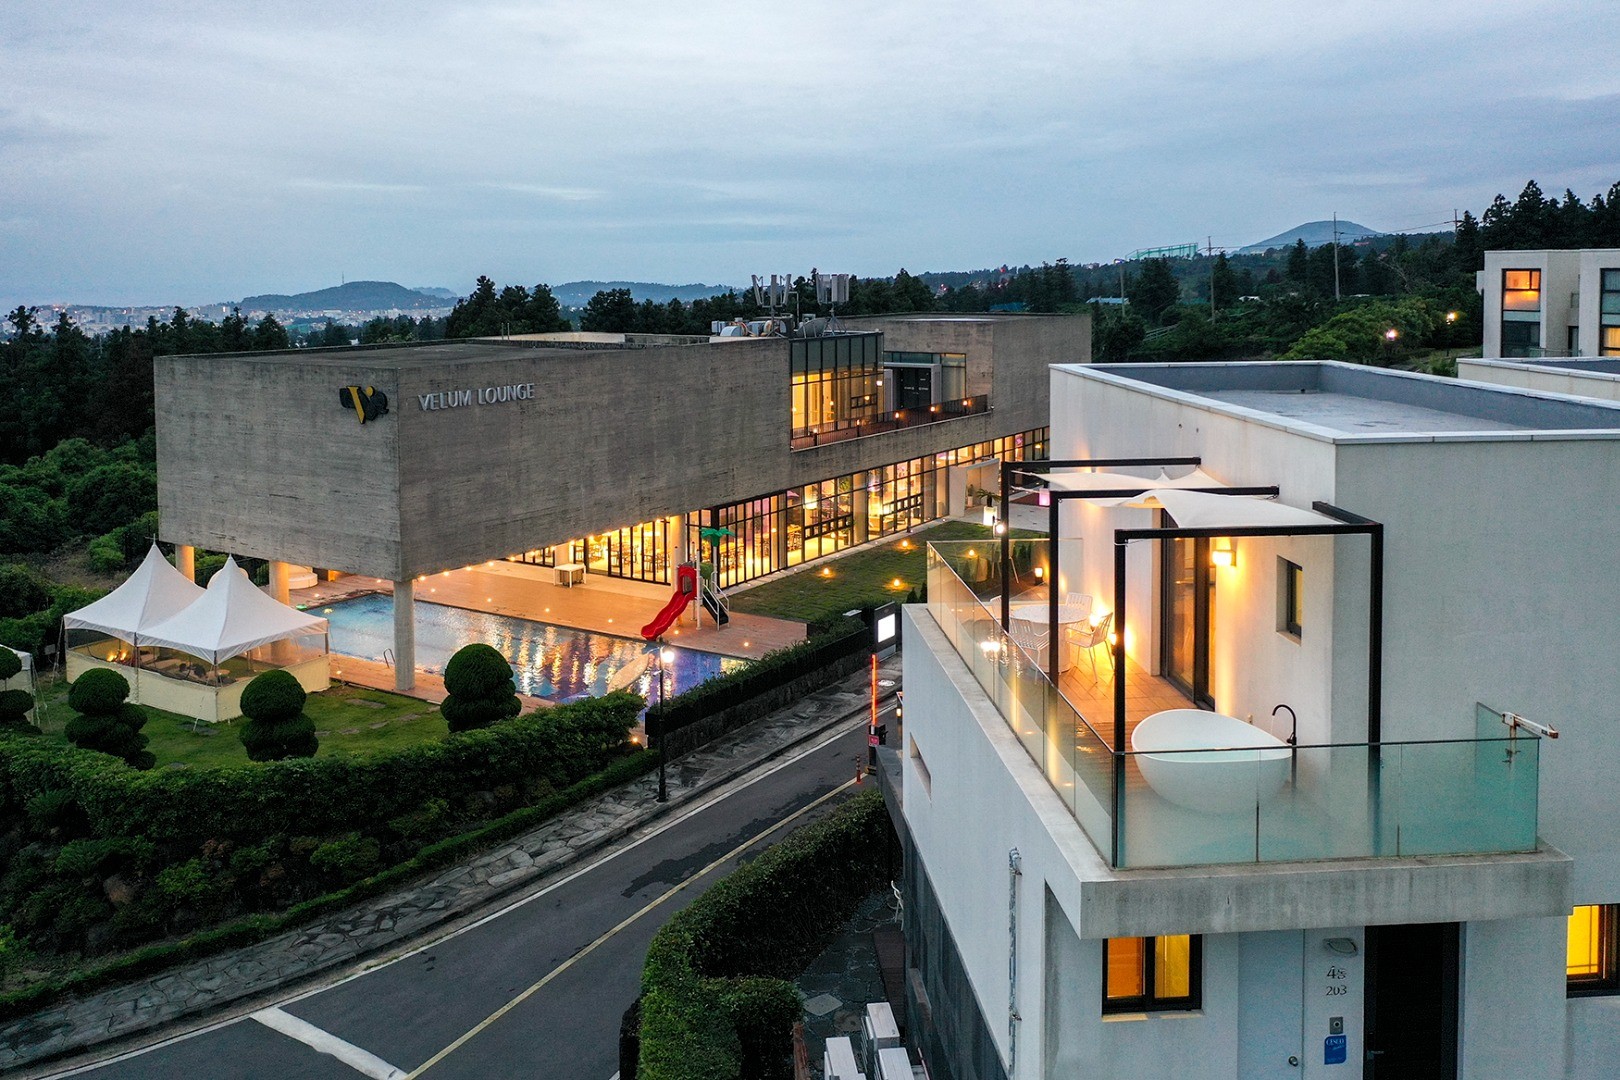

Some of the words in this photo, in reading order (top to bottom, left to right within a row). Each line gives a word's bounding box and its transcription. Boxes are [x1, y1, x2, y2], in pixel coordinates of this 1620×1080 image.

[418, 390, 472, 412] VELUM
[478, 382, 536, 405] LOUNGE
[1325, 984, 1347, 996] 203
